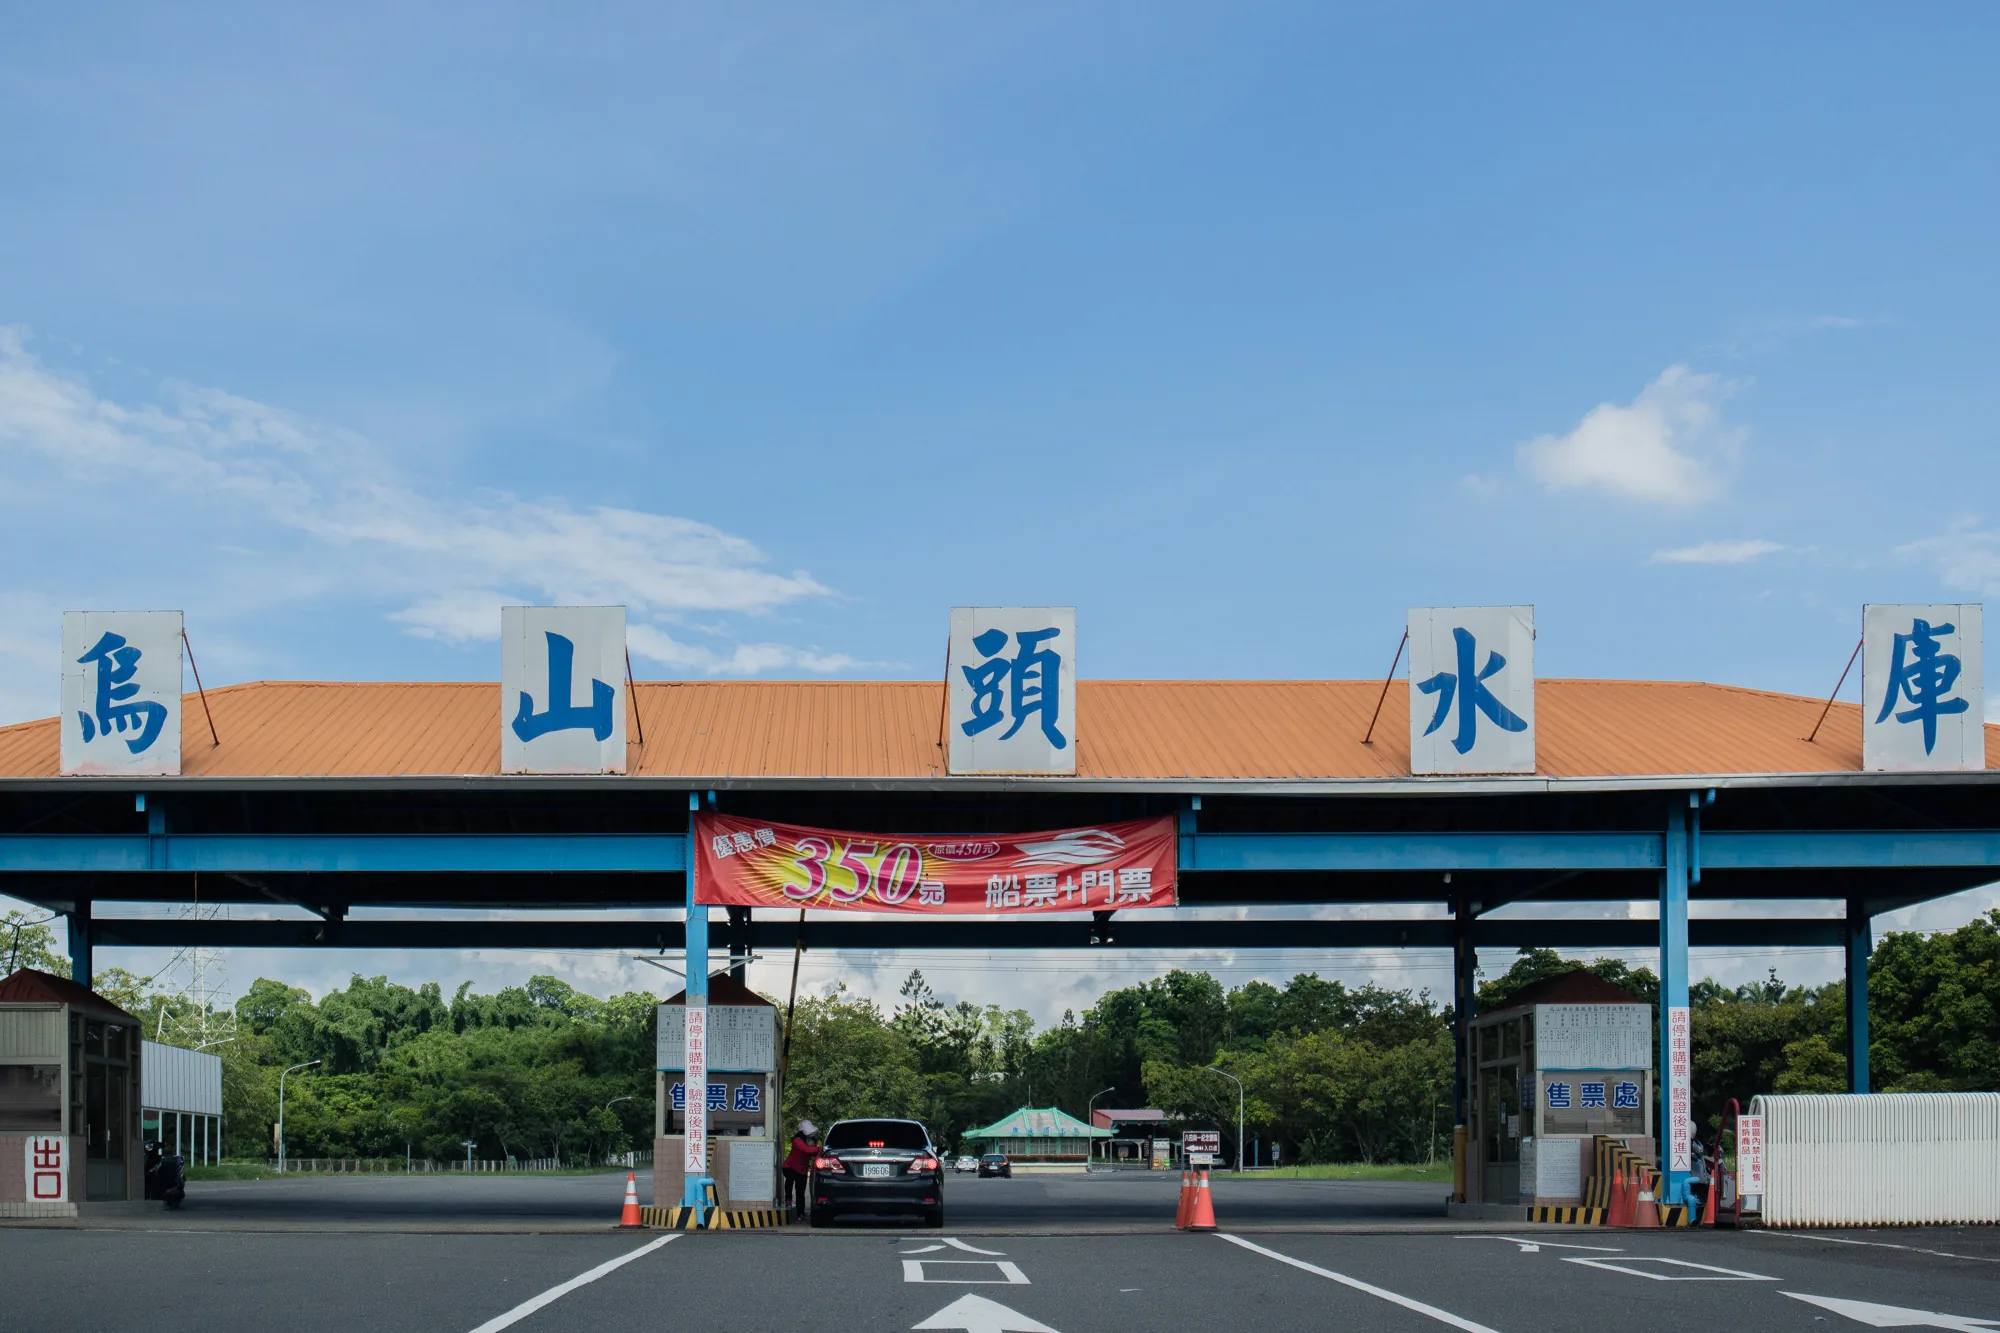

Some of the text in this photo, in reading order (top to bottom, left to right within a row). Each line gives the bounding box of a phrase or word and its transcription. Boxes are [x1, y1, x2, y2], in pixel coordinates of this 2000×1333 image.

[512, 631, 615, 742] 山
[961, 627, 1067, 750] 頭
[1416, 626, 1528, 754] 水
[1874, 618, 1969, 757] 庫
[712, 828, 777, 860] 優惠價
[934, 843, 994, 856] 原價450元
[985, 867, 1153, 908] 船票+門票
[688, 1011, 703, 1169] 請停車購票、驗證後再進入
[1546, 1082, 1639, 1108] 售票處
[1672, 1011, 1688, 1168] 請停車購票、驗證後再進入
[34, 1139, 61, 1198] 出口
